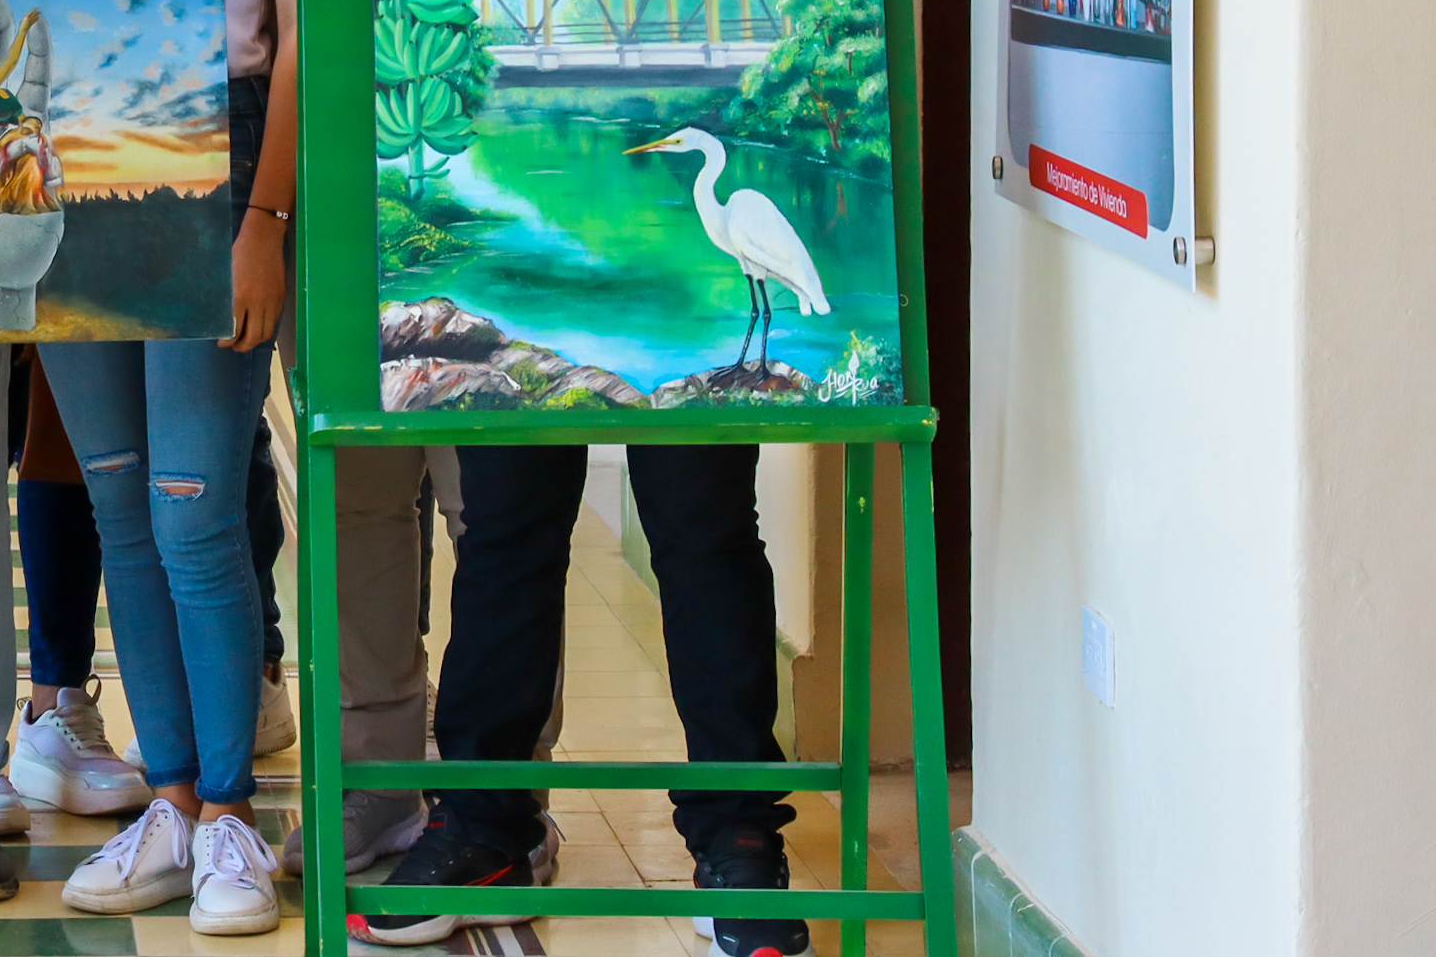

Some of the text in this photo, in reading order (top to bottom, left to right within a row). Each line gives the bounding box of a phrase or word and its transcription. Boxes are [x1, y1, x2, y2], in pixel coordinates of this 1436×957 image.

[1046, 161, 1128, 219] Mejoramiento de Vivienda
